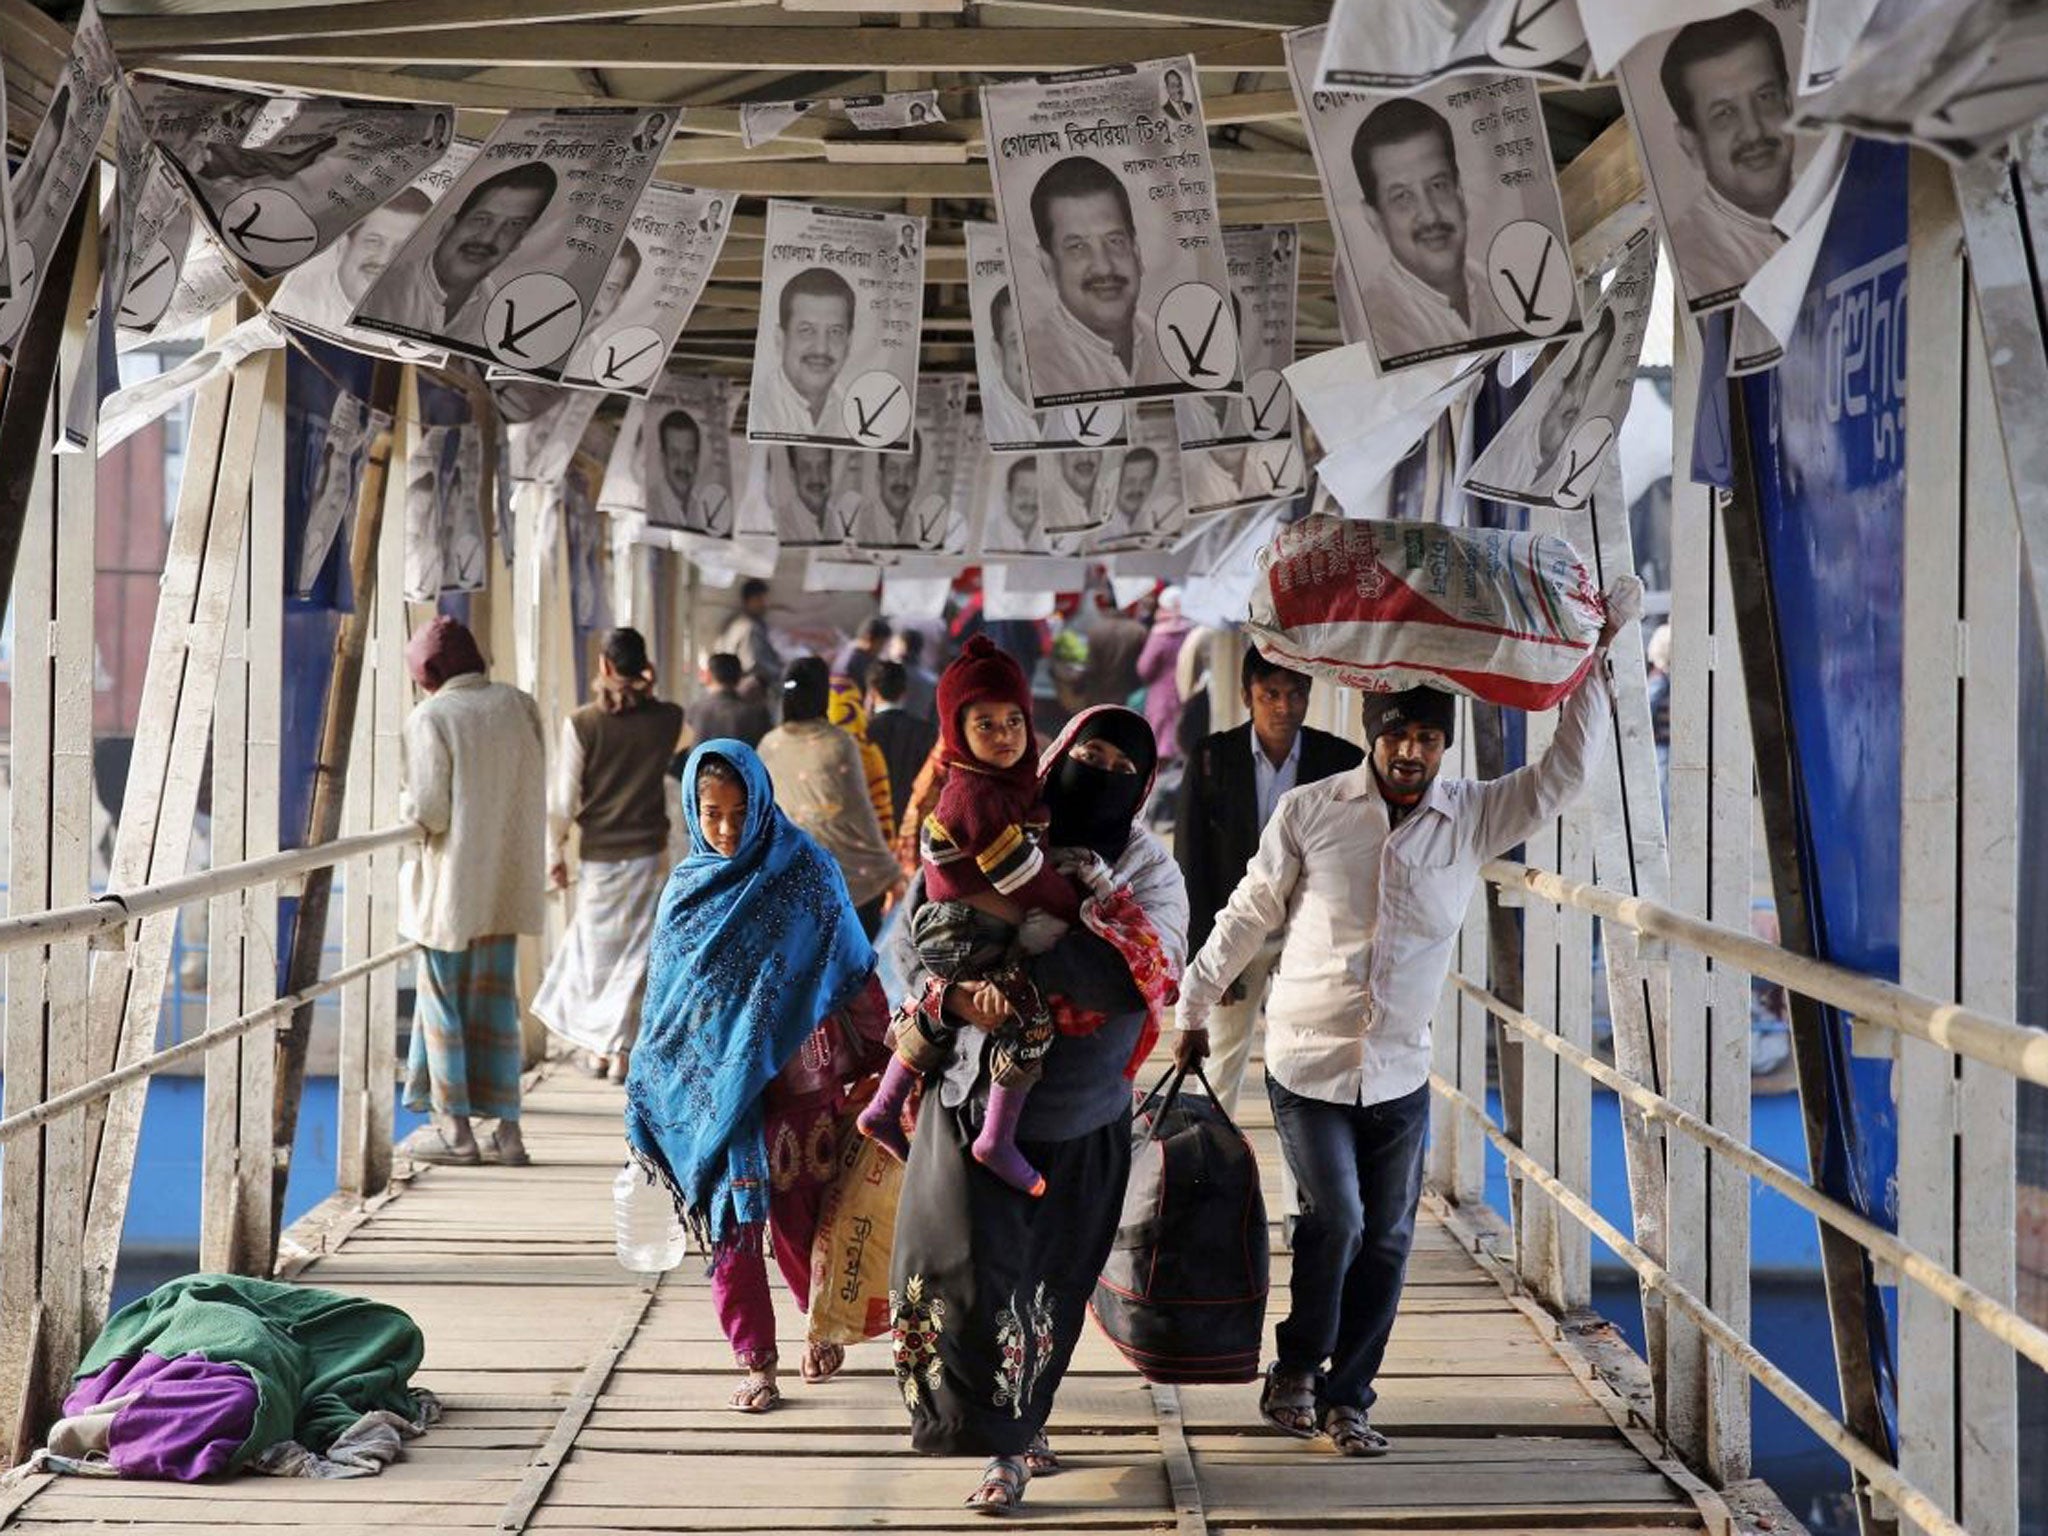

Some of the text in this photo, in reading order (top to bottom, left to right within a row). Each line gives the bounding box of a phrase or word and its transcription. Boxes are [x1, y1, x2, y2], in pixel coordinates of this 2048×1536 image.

[1001, 130, 1061, 159] গোলাম
[1065, 118, 1132, 150] কিবরিয়া
[840, 1215, 873, 1304] সিমেন্ট
